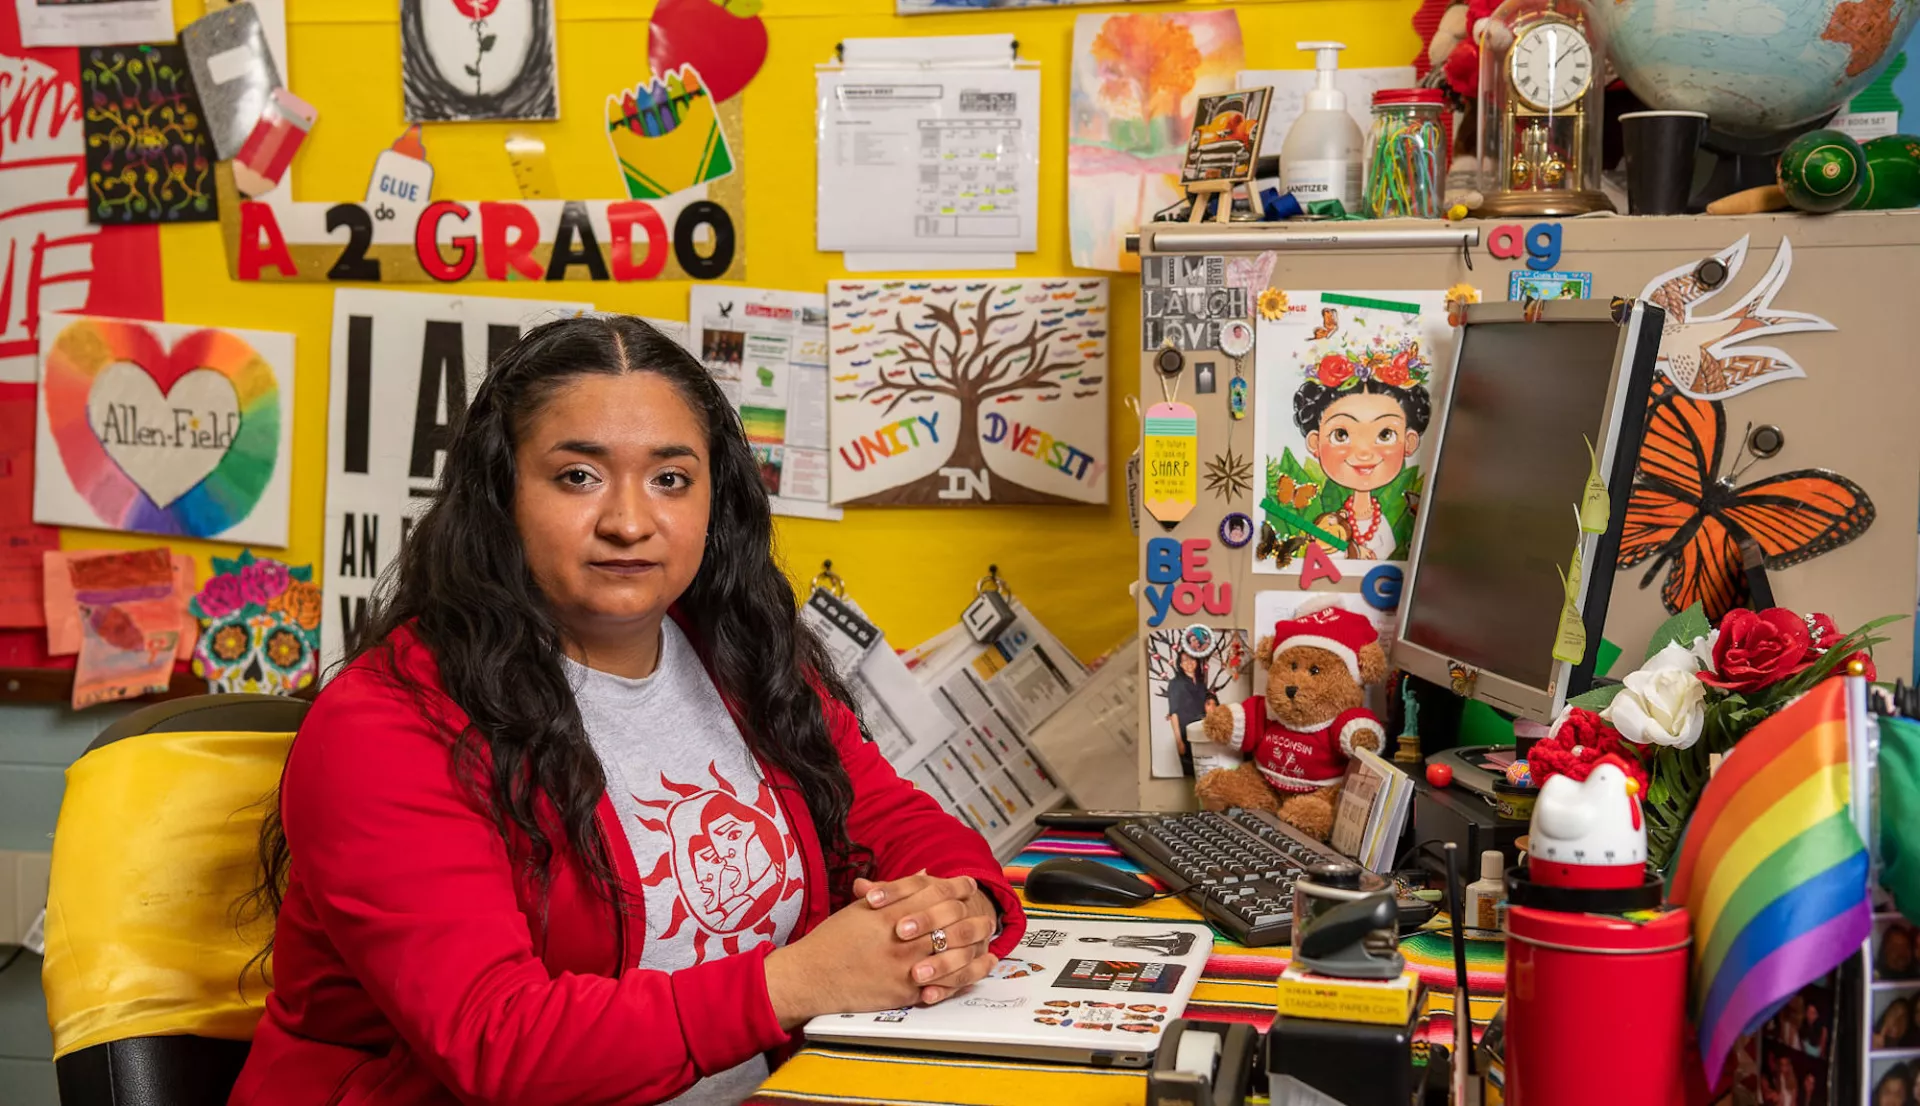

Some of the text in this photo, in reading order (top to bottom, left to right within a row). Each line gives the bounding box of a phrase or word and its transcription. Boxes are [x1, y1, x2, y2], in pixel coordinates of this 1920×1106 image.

[379, 175, 419, 202] GLUE
[238, 201, 299, 281] A
[415, 200, 736, 282] GRADO
[1144, 256, 1223, 287] LIVE
[1144, 287, 1247, 320] LAUGH
[344, 314, 374, 476] I
[102, 401, 237, 450] Allen-Field
[838, 411, 1107, 489] UNITY DIVERSITY
[1151, 460, 1191, 477] SHARP
[937, 467, 992, 501] IN
[339, 512, 379, 579] AN
[1146, 537, 1213, 584] BE
[1285, 998, 1400, 1017] STANDARD PAPER CLIPS
